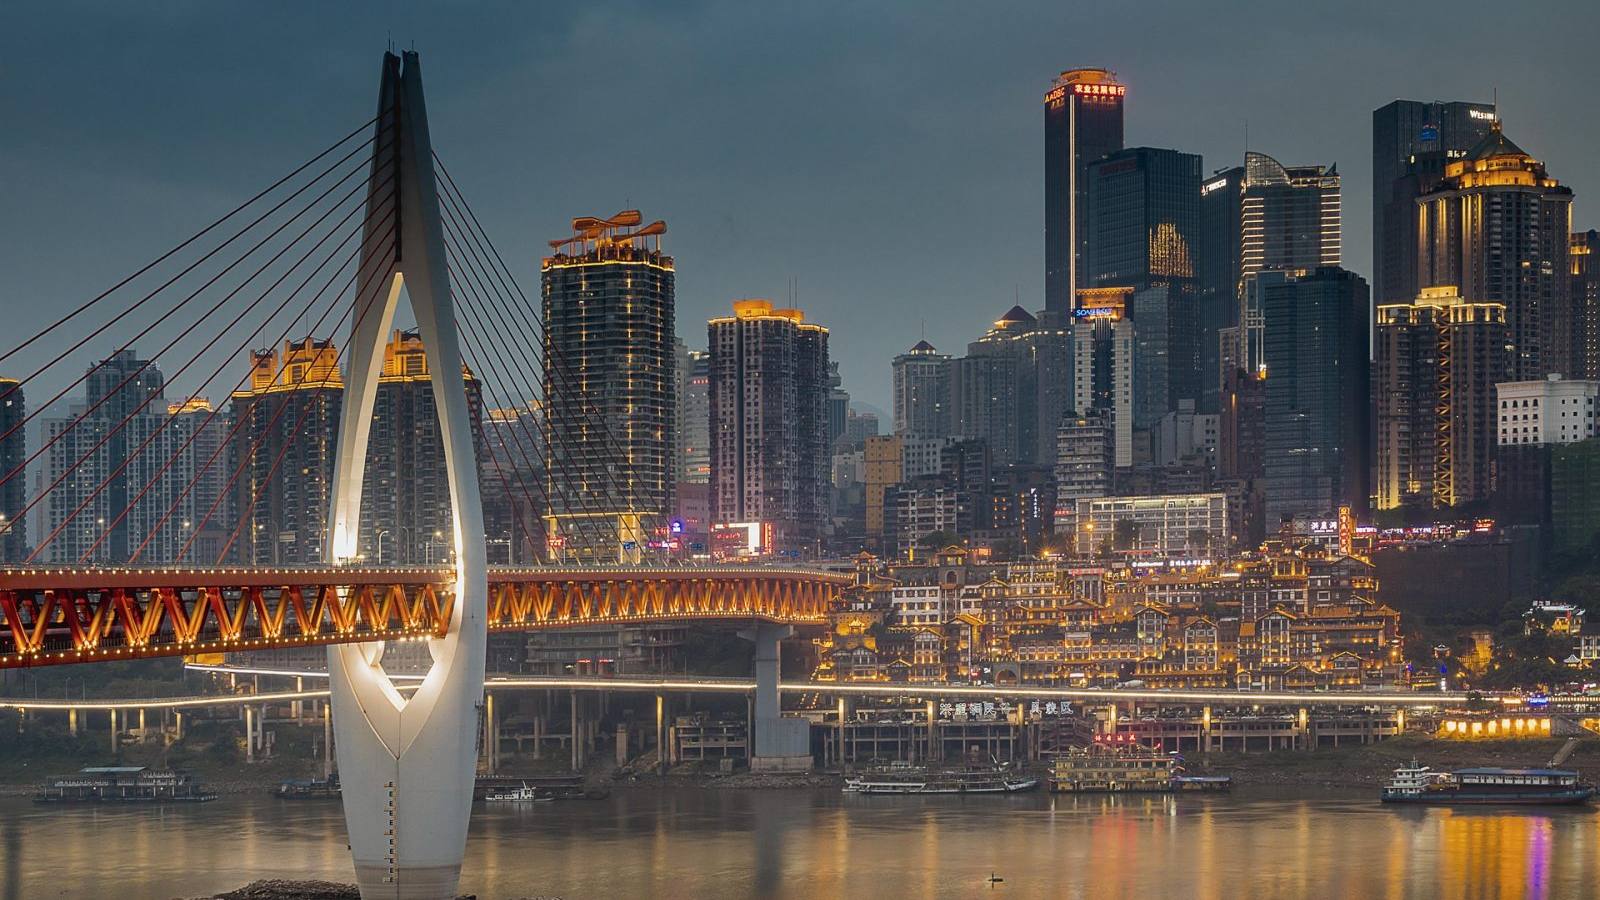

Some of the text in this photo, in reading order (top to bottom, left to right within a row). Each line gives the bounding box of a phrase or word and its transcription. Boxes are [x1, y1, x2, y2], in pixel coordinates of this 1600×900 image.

[1075, 84, 1125, 96] 农业发展银行
